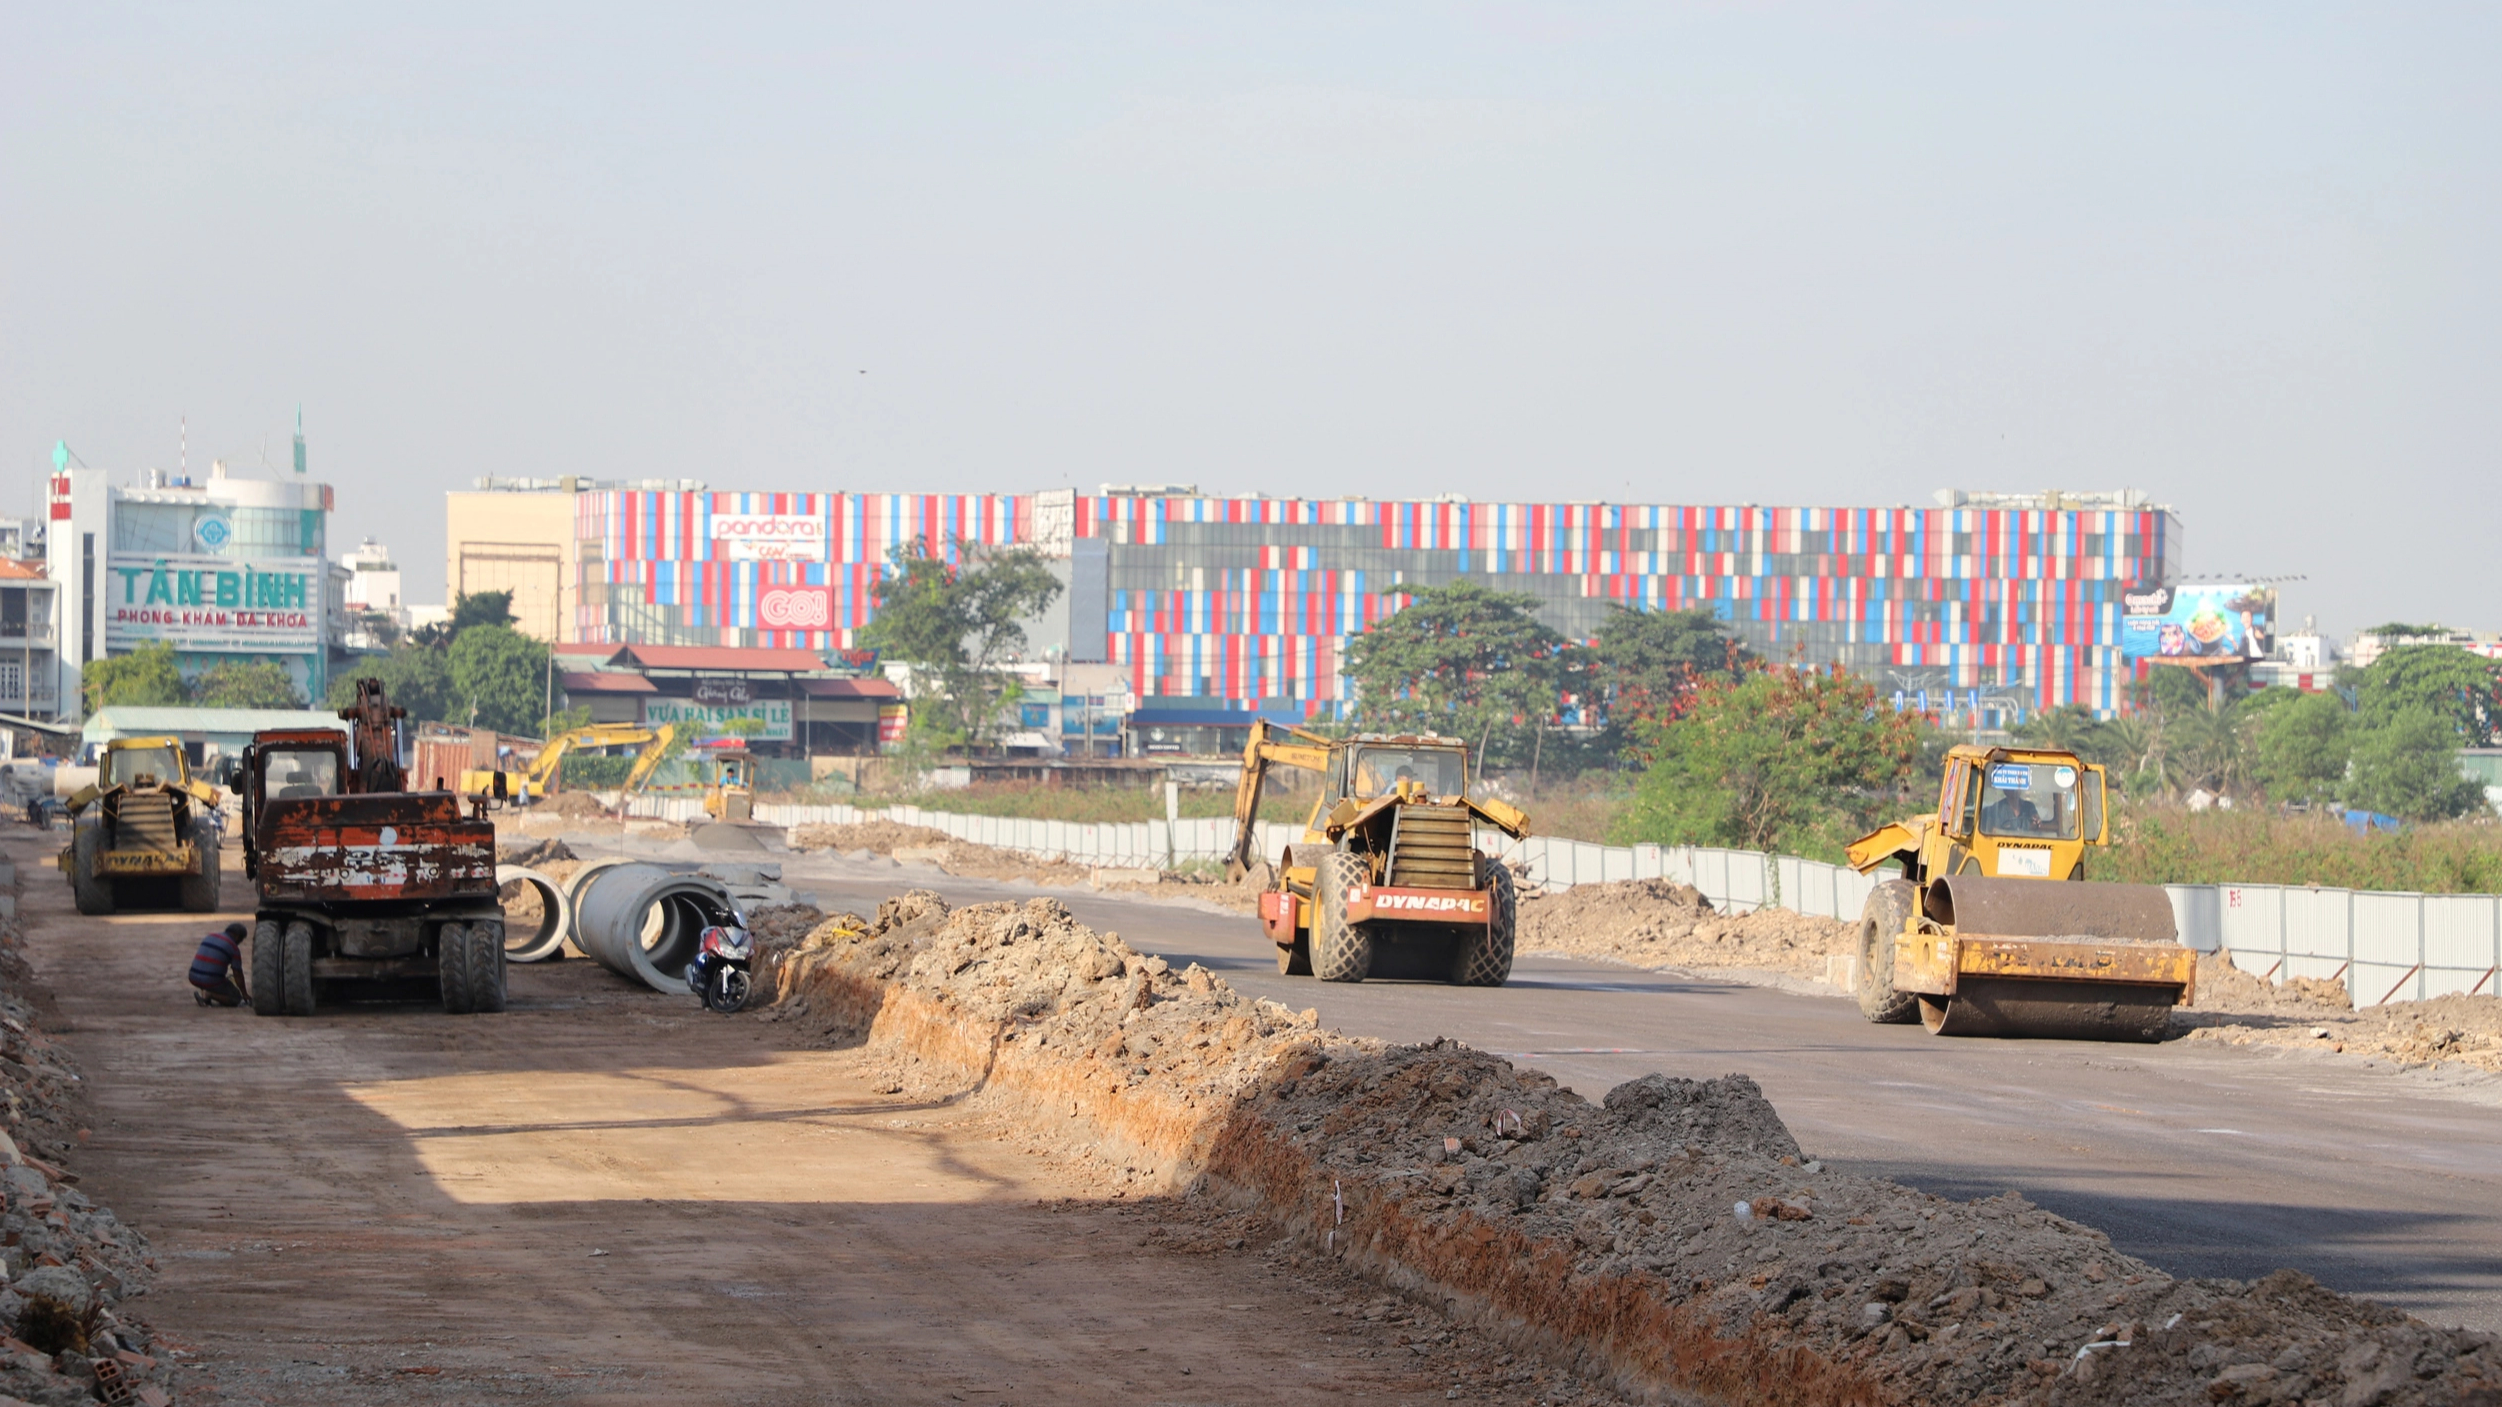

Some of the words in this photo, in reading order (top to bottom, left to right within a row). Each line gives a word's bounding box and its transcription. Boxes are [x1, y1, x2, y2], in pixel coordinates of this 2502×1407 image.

[717, 515, 815, 540] pandora
[117, 558, 202, 606] TÂN
[215, 563, 306, 609] BÌNH
[182, 607, 227, 626] KHÁM
[266, 613, 308, 628] KHOA
[761, 589, 827, 627] GO!
[1997, 842, 2056, 851] DYNAPAC
[1375, 894, 1485, 912] DYNAPAC
